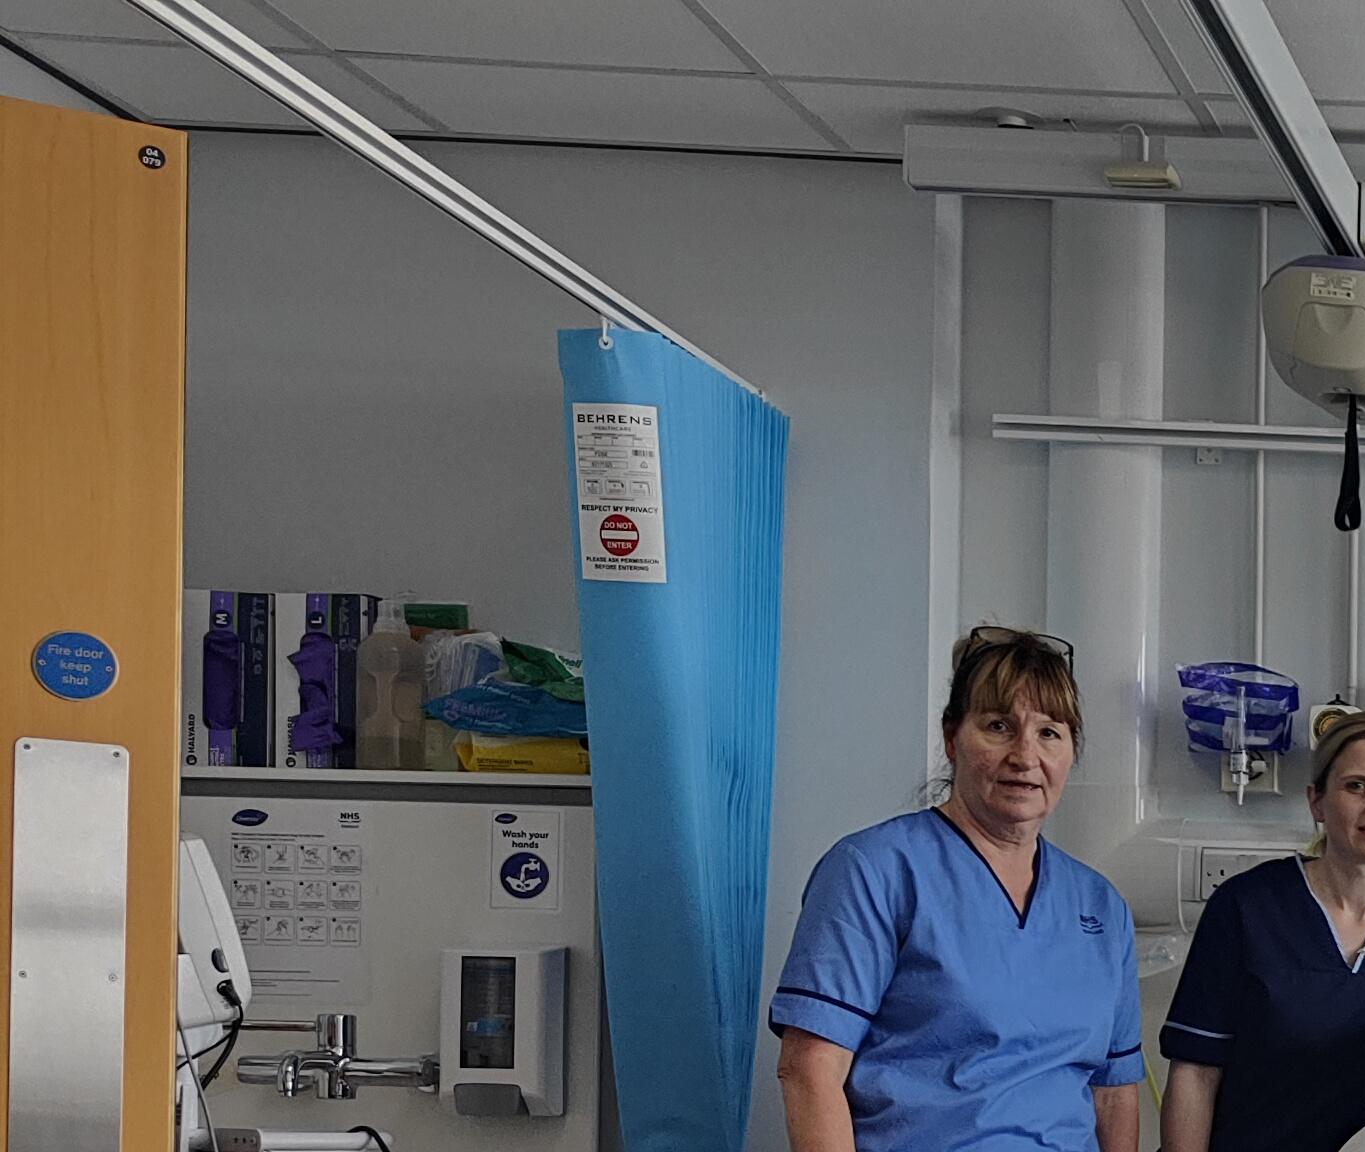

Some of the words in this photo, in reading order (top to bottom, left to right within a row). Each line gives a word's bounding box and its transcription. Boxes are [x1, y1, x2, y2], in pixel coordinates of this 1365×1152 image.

[577, 414, 652, 425] BEHRENS
[581, 504, 611, 512] RESPECT
[625, 506, 659, 514] PRIVACY
[604, 521, 615, 529] DO
[616, 522, 633, 530] NOT
[607, 541, 633, 549] ENTER
[215, 613, 228, 625] M
[311, 617, 323, 625] L
[48, 644, 72, 656] Fire
[74, 648, 104, 659] door
[60, 659, 92, 673] keep
[62, 674, 89, 686] shut
[188, 714, 196, 754] HALYARD
[340, 812, 360, 820] NHS
[502, 830, 527, 838] Wash
[529, 832, 550, 840] your
[512, 841, 539, 849] hands
